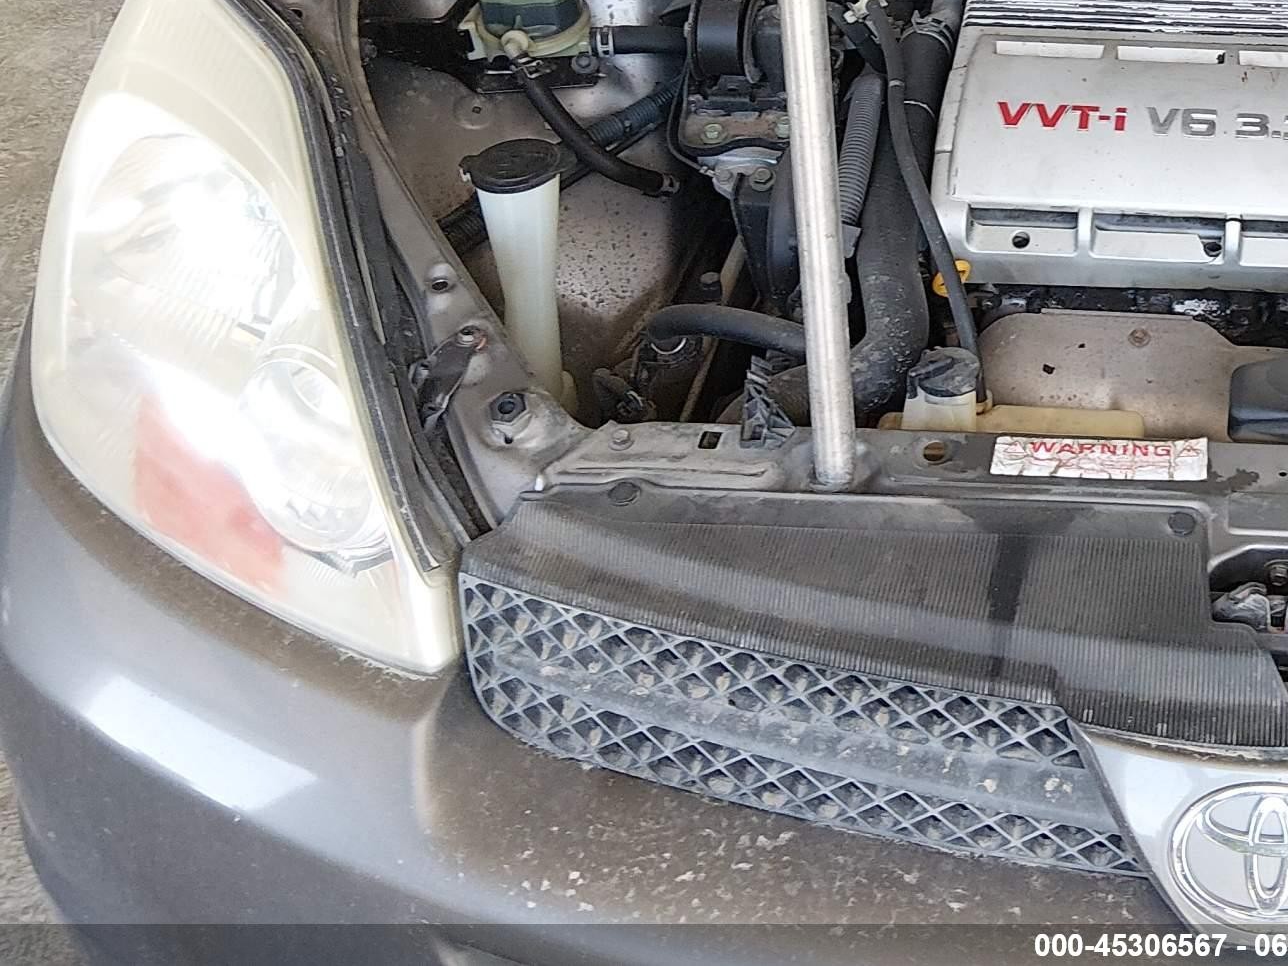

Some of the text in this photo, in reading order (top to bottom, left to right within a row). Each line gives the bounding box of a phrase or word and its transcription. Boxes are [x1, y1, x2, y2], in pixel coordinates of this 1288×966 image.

[997, 101, 1128, 131] VVT-i
[1146, 107, 1217, 137] V6
[1030, 441, 1172, 457] WARNING
